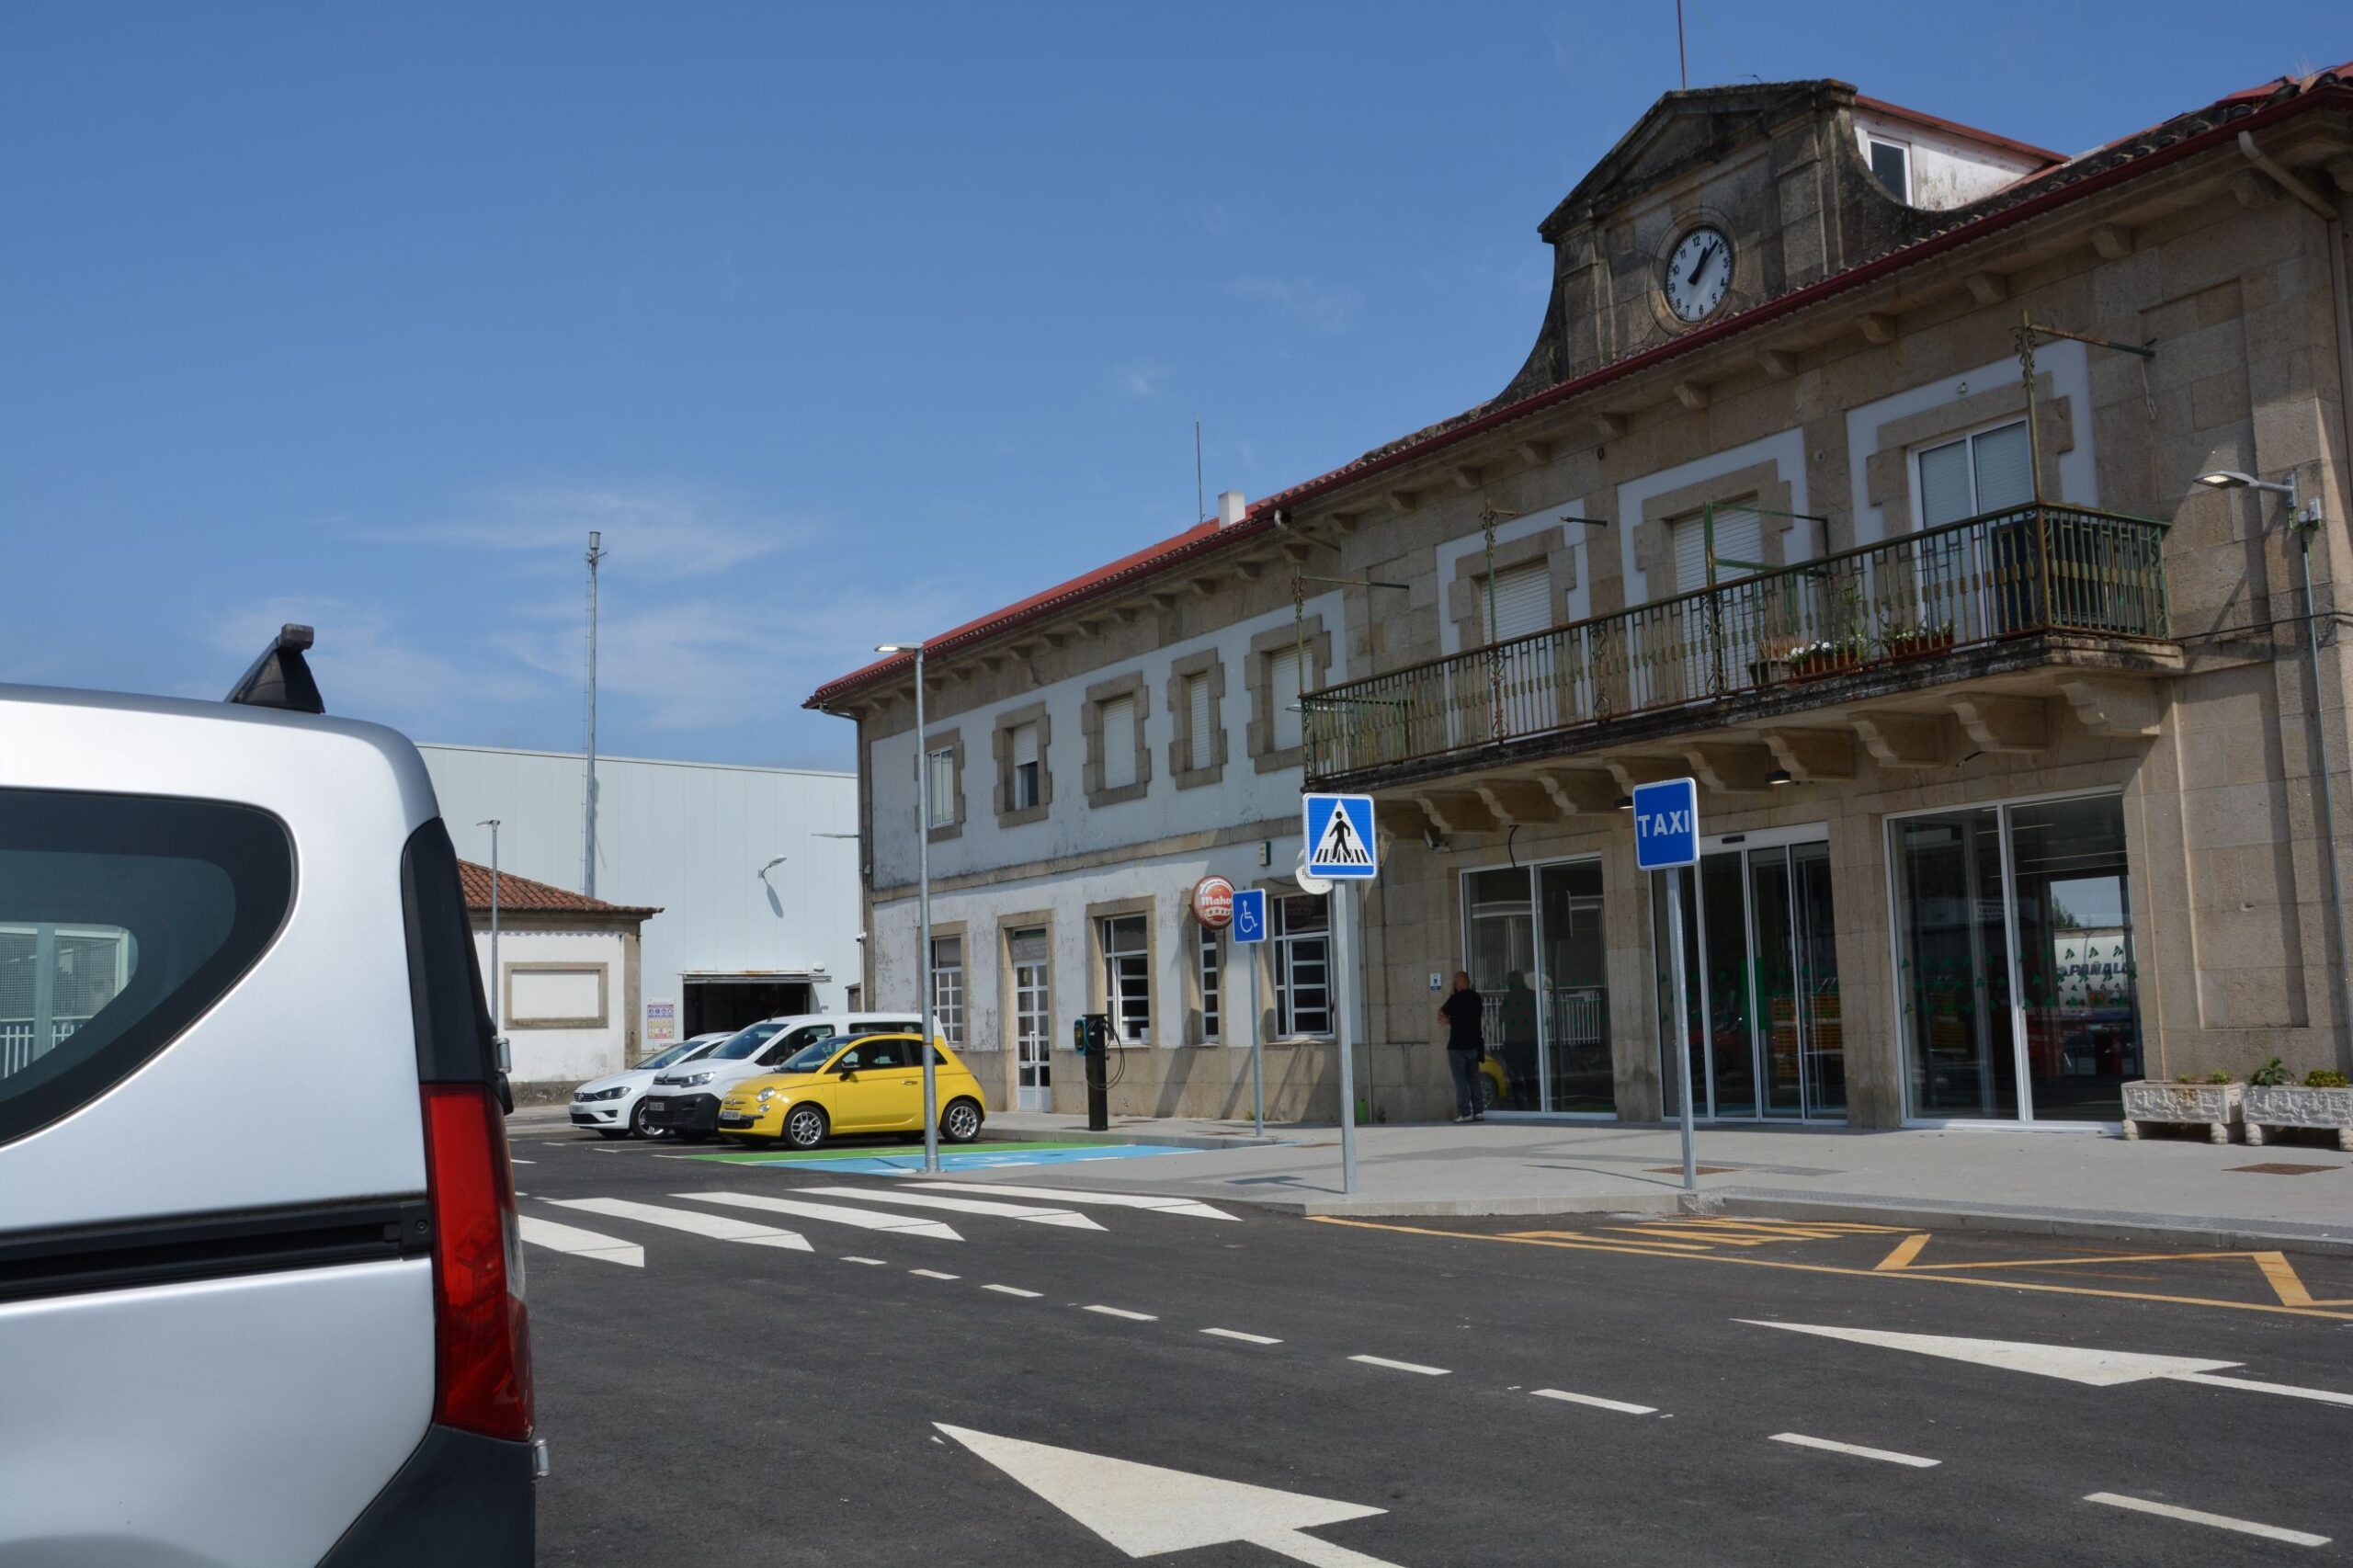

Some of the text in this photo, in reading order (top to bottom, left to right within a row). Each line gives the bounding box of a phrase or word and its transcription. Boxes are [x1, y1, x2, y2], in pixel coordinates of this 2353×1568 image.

[1693, 235, 1700, 247] 12
[1680, 248, 1687, 260] 11
[1673, 265, 1680, 277] 10
[1637, 810, 1690, 837] TAXI
[1201, 895, 1233, 906] Maho
